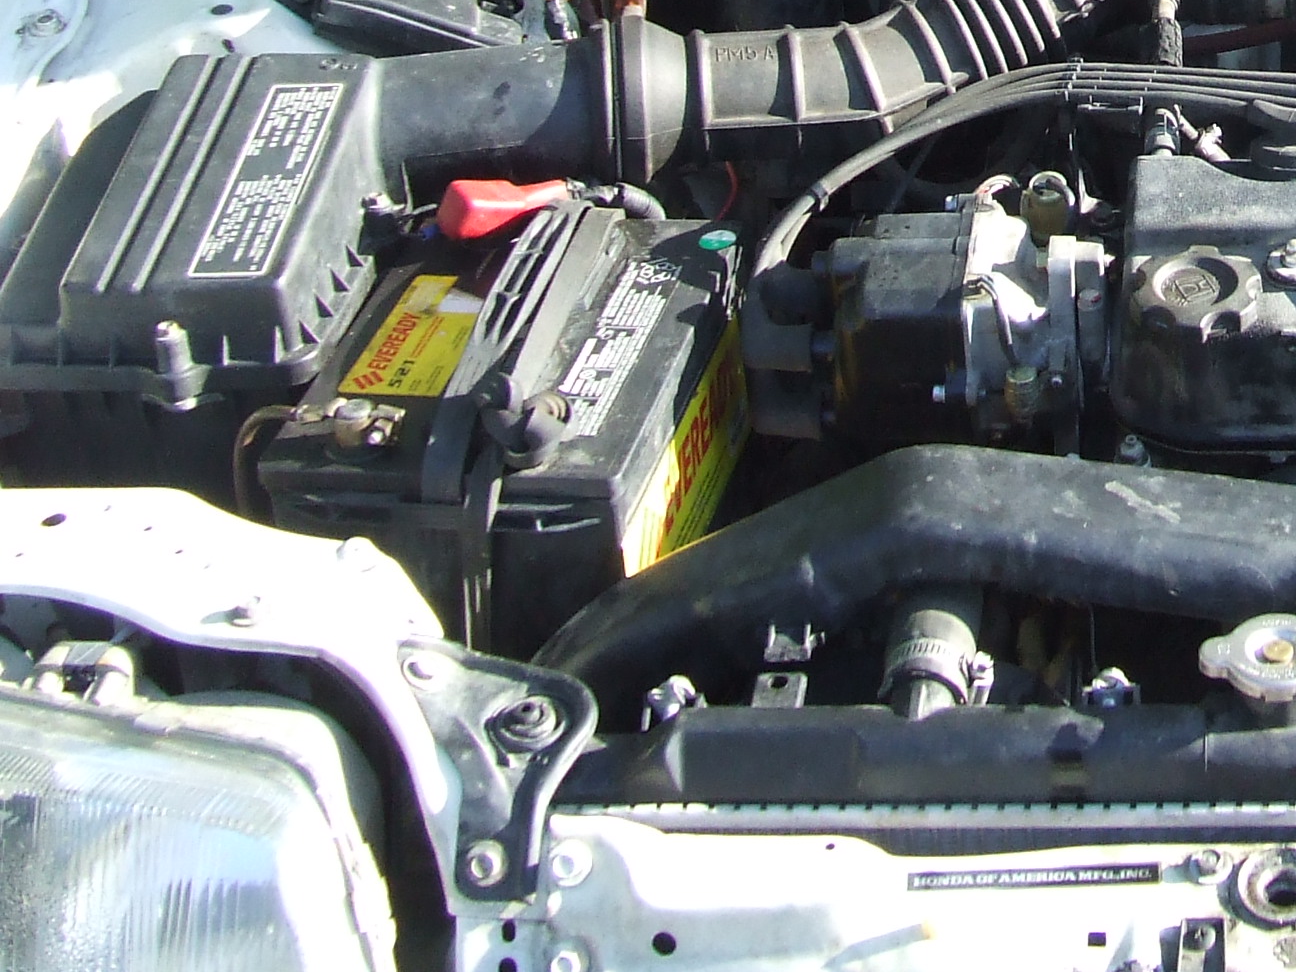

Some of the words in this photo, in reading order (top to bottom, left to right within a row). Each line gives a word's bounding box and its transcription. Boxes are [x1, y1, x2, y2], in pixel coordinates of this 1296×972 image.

[367, 312, 421, 371] EVEREADY
[388, 359, 416, 388] 521
[913, 874, 974, 887] HONDA
[976, 874, 997, 884] OF
[998, 871, 1075, 883] AMERICA
